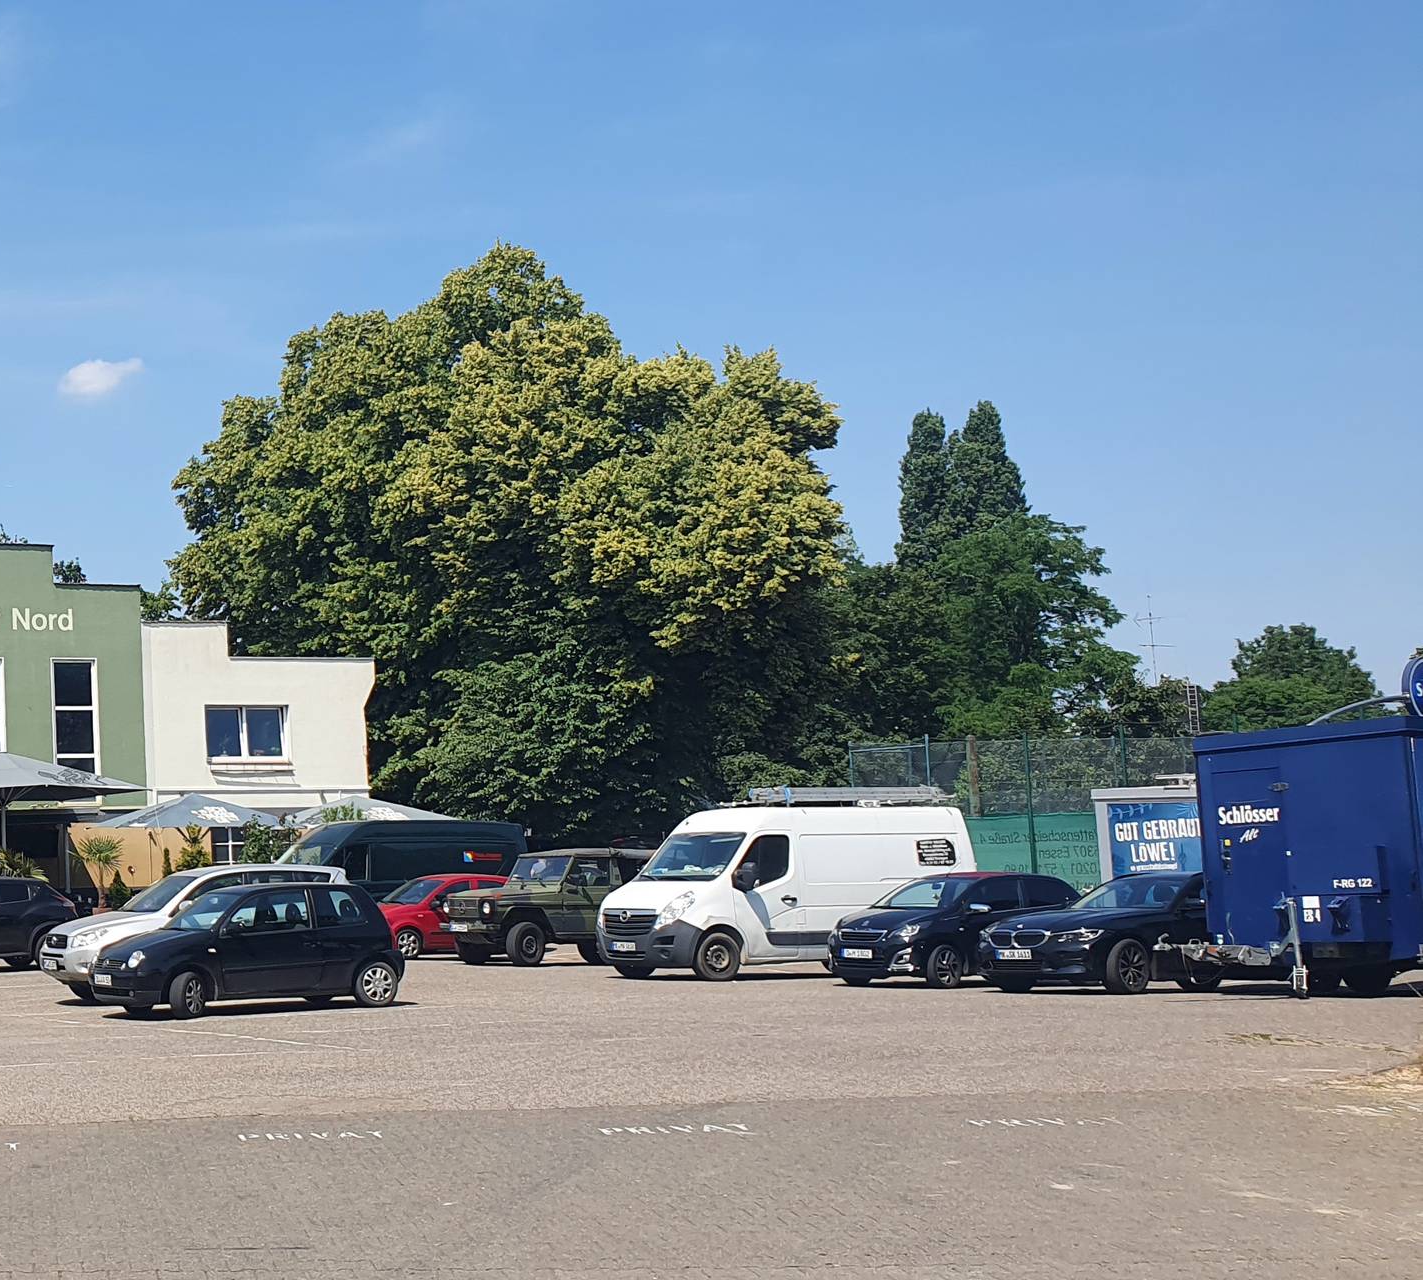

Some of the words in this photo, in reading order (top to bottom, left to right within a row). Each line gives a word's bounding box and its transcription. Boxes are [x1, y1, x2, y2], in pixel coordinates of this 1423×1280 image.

[12, 607, 74, 631] Nord
[1218, 805, 1280, 825] Schlösser
[1114, 822, 1138, 842] GUT
[1239, 828, 1259, 843] Alt
[1131, 842, 1176, 862] LÖWE!
[1333, 879, 1355, 889] F-RG
[1357, 878, 1373, 888] 122
[238, 1130, 383, 1140] PRIVAT
[597, 1123, 760, 1136] PRIVAT
